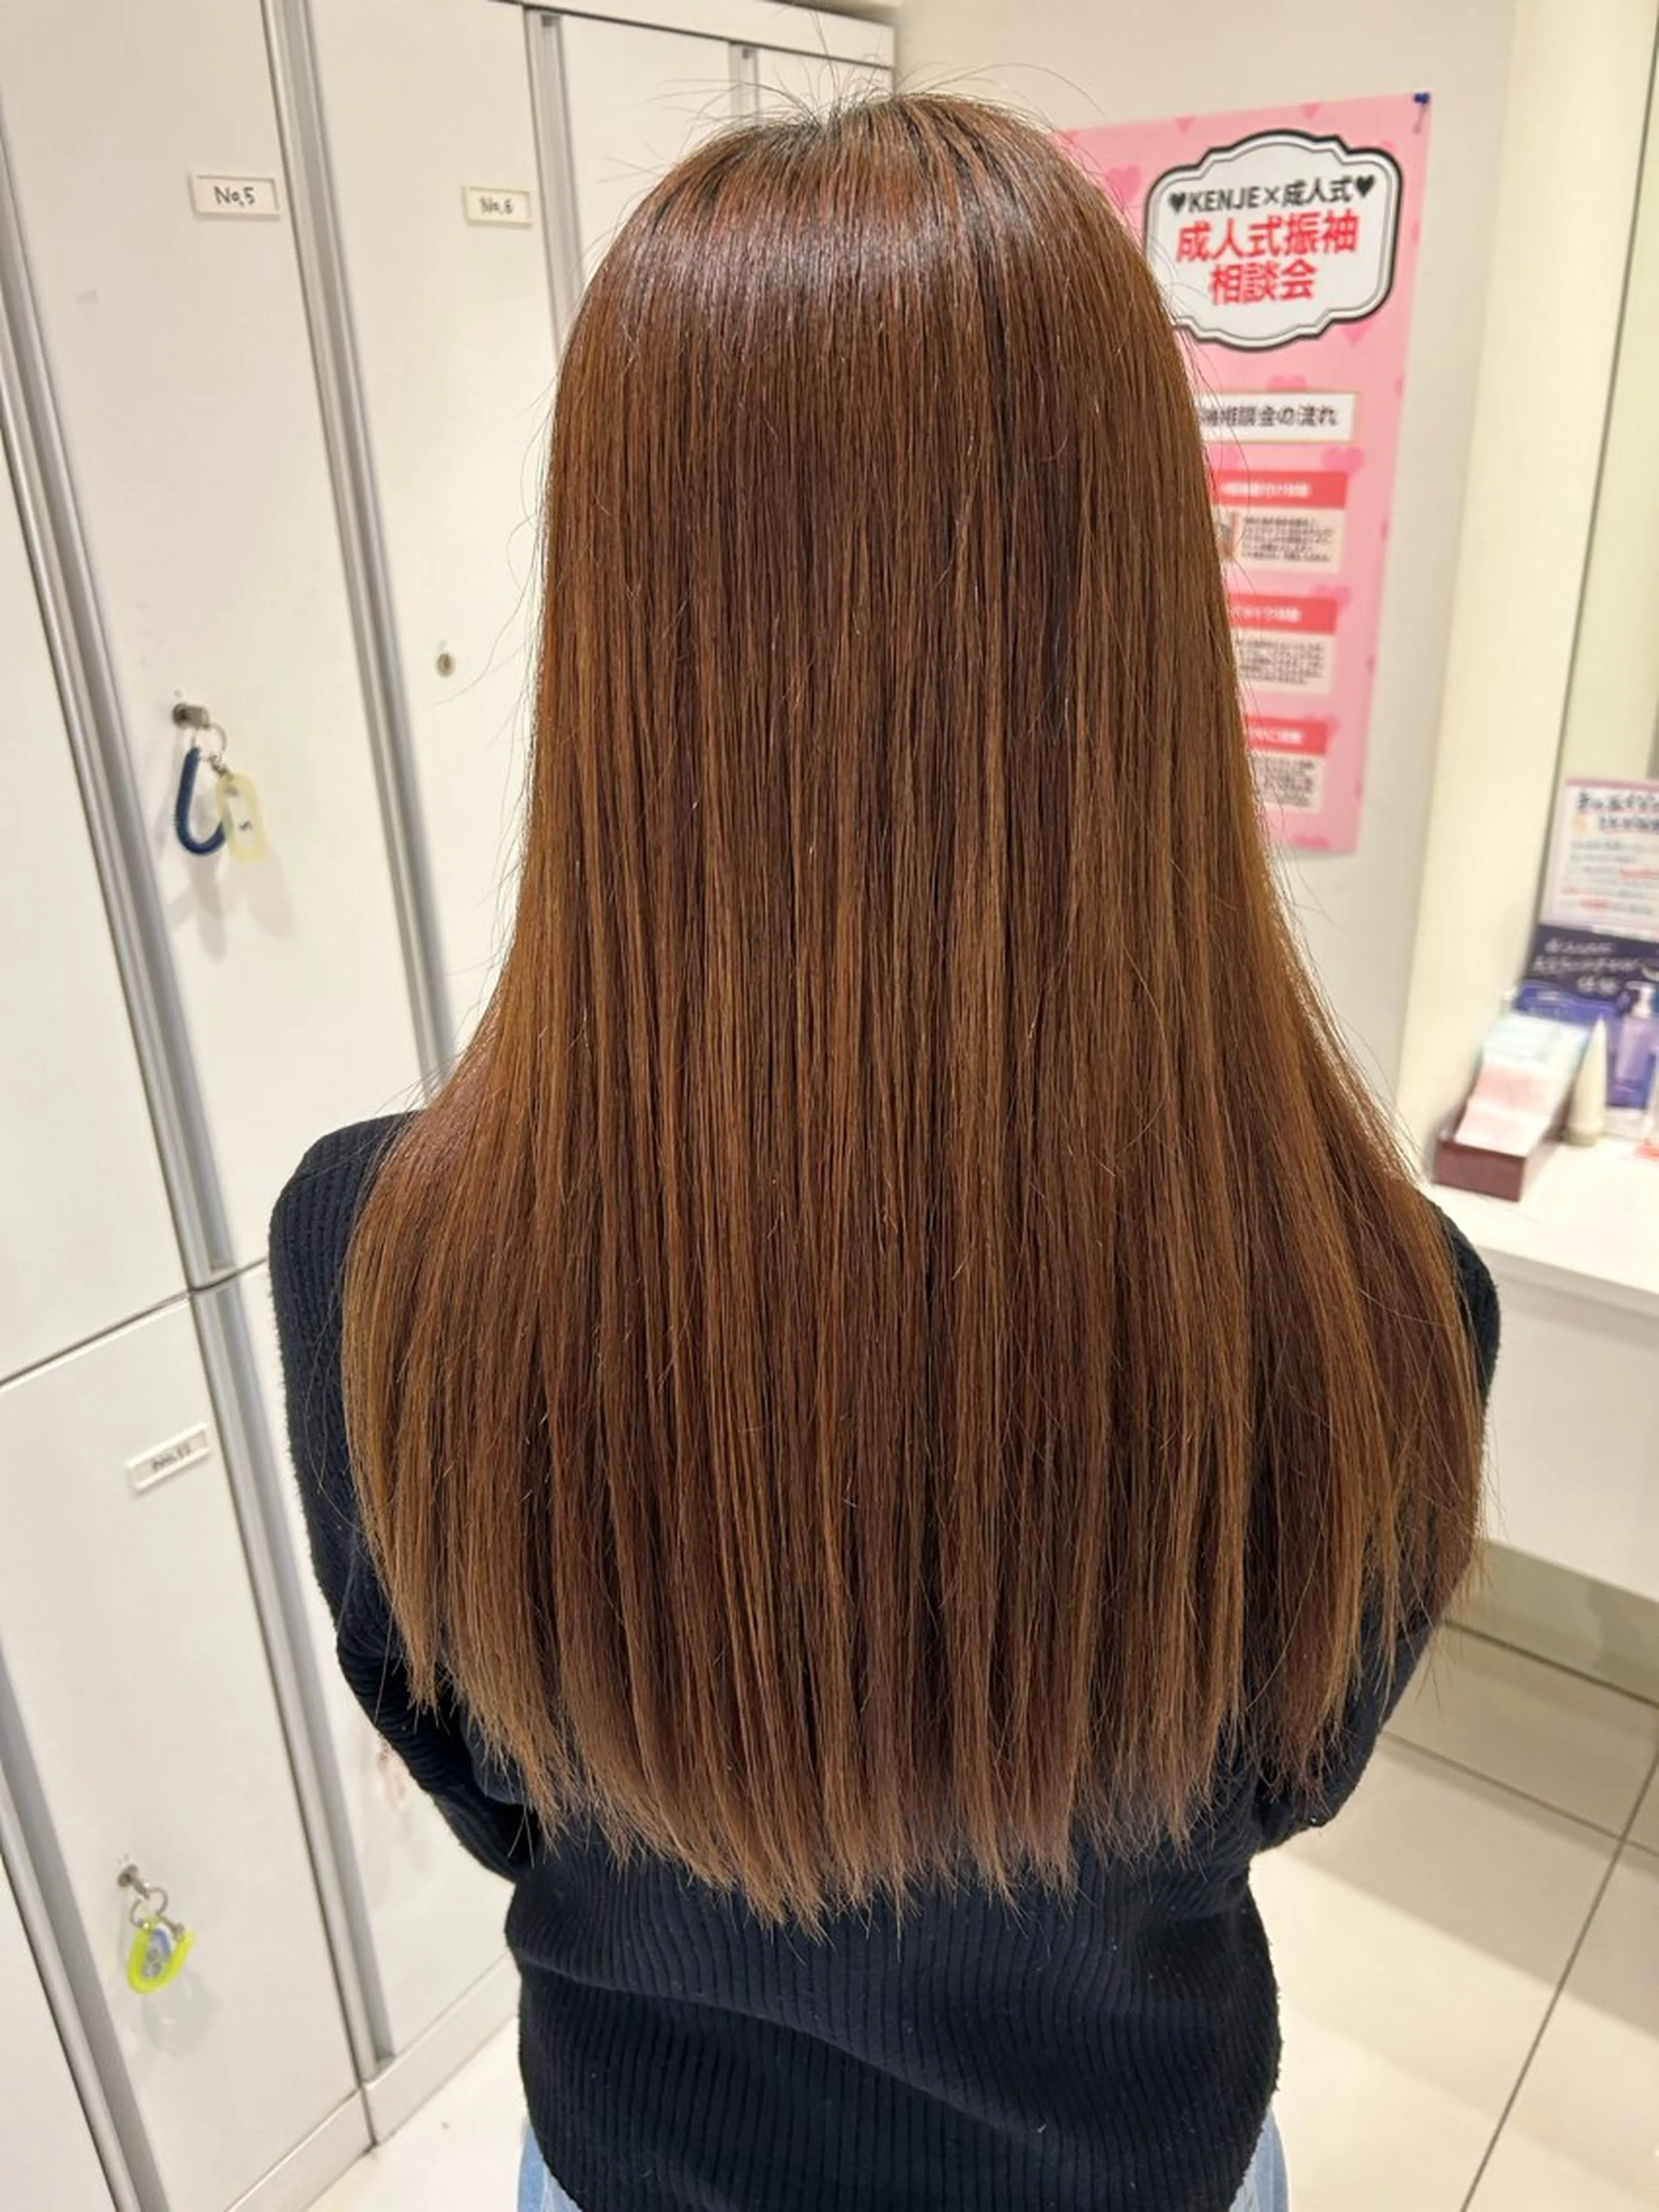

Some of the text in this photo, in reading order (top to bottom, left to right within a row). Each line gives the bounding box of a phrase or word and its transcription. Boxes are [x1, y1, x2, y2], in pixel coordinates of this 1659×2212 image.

[1176, 208, 1360, 263] 成人式振袖
[1211, 258, 1317, 305] 相談会
